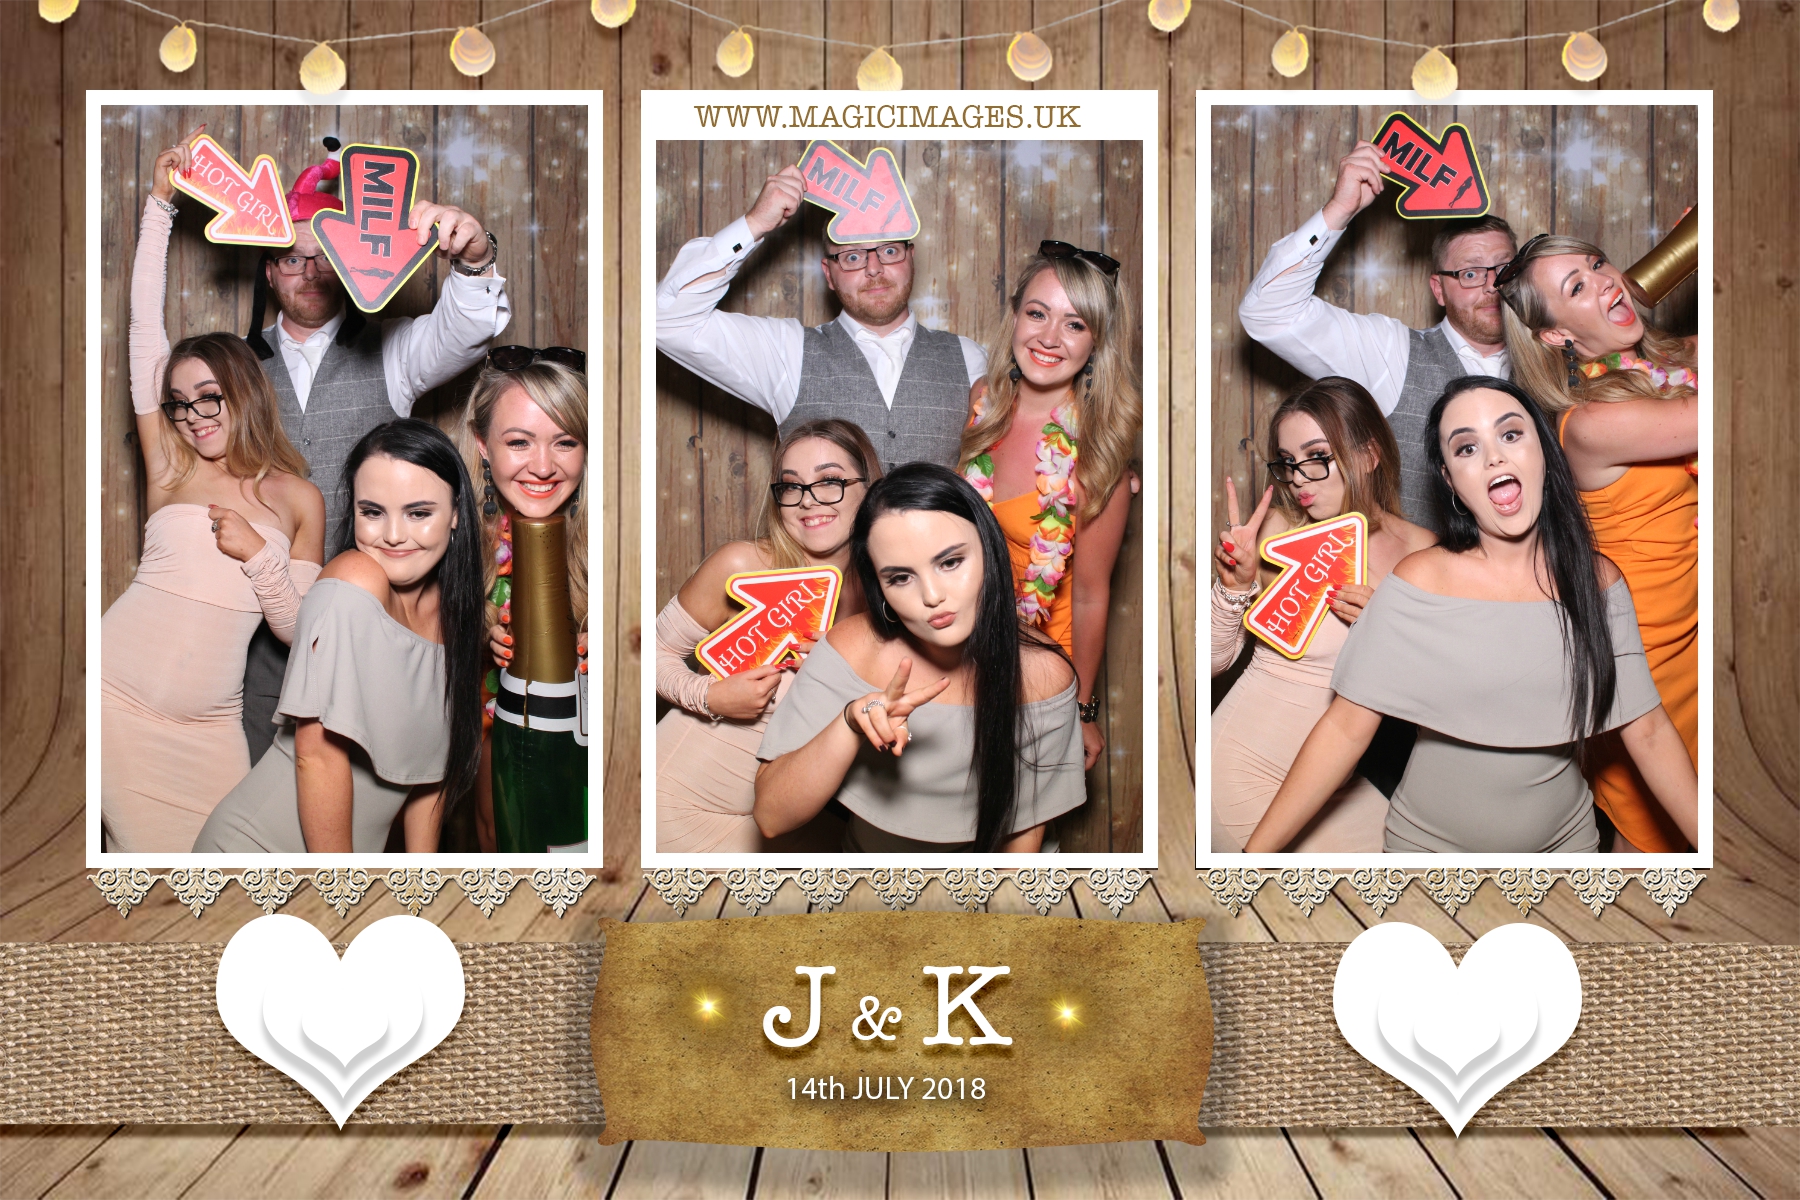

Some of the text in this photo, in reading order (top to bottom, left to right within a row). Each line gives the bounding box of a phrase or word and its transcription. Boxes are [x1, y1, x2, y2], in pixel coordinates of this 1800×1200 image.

[191, 154, 280, 235] HOT GIRL
[806, 156, 886, 214] MILF
[1382, 130, 1458, 190] MILF
[359, 160, 396, 258] MILF
[718, 581, 825, 671] HOT GIRL
[1266, 532, 1355, 635] HOT GIRL
